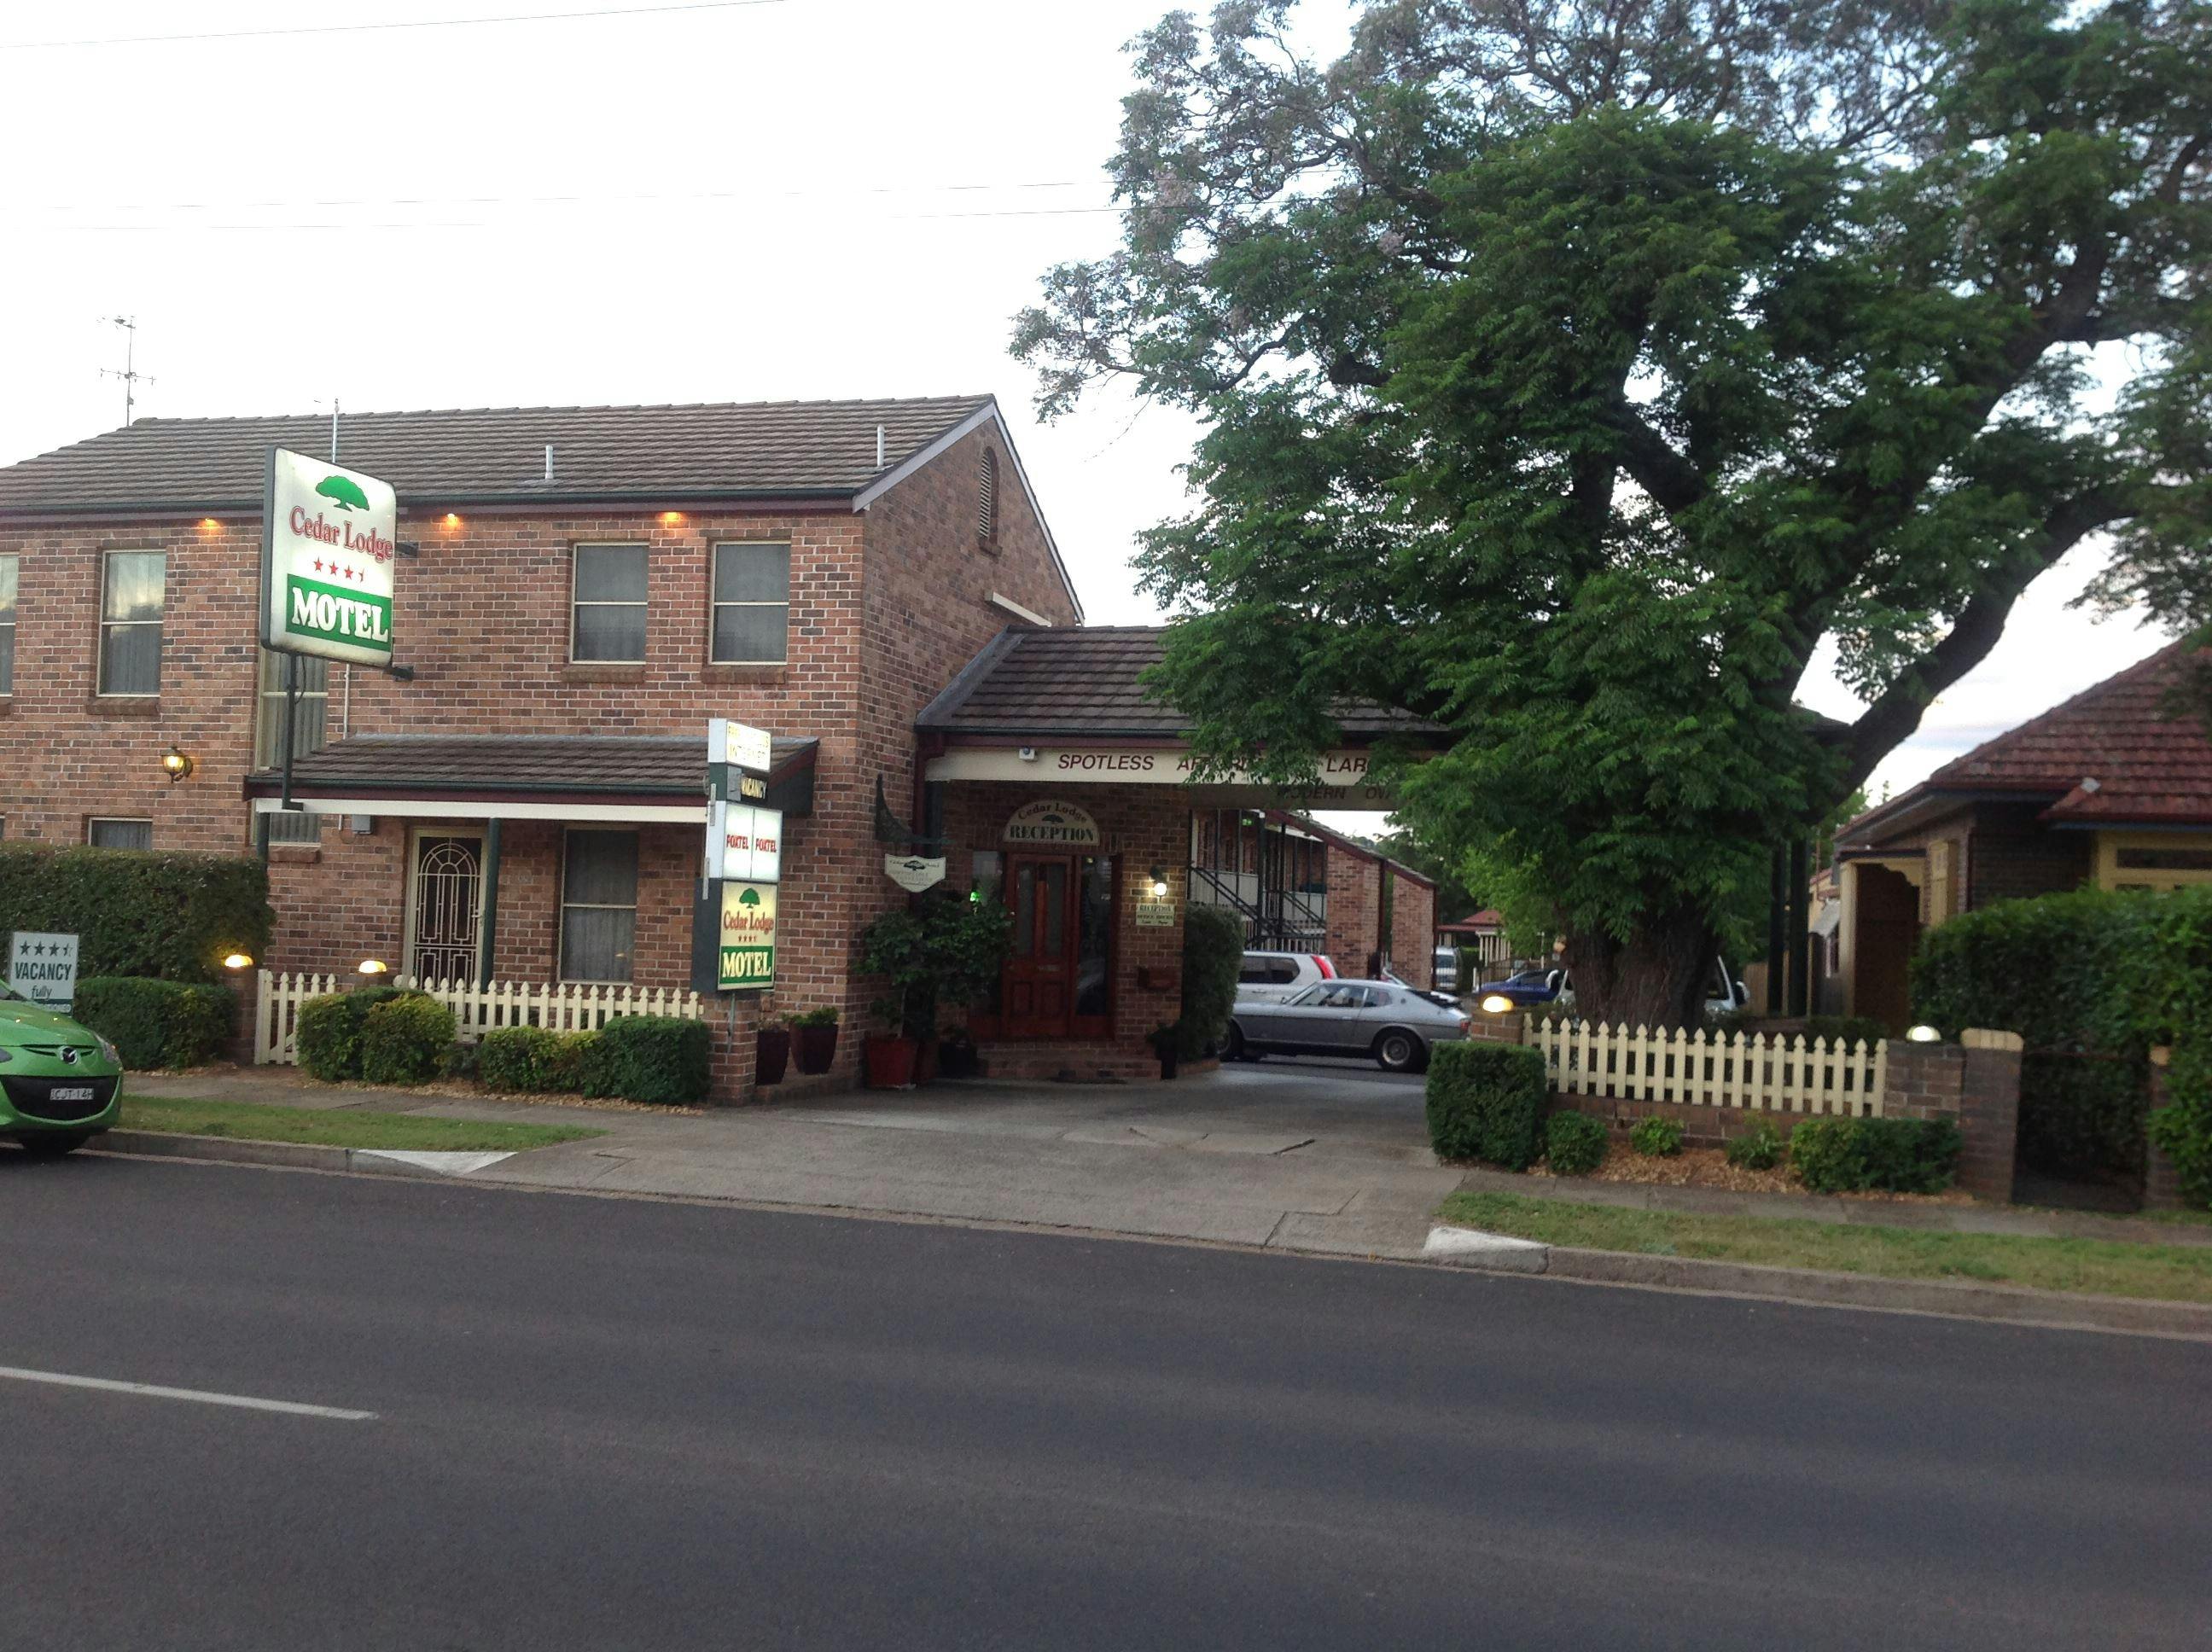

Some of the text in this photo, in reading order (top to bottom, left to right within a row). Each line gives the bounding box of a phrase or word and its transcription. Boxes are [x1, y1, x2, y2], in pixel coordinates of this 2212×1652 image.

[289, 506, 393, 563] Cedar Lodge
[292, 586, 388, 643] MOTEL
[1058, 754, 1154, 770] SPOTLESS
[1326, 757, 1370, 772] LAR
[1018, 802, 1089, 822] Cedar Lodge
[1010, 824, 1095, 841] RECEPTION
[726, 835, 777, 853] FOXTEL FOXTEL
[724, 910, 774, 935] Cedar Lodge
[15, 962, 73, 980] VACANCY
[722, 951, 771, 979] MOTEL
[32, 985, 52, 1002] fully
